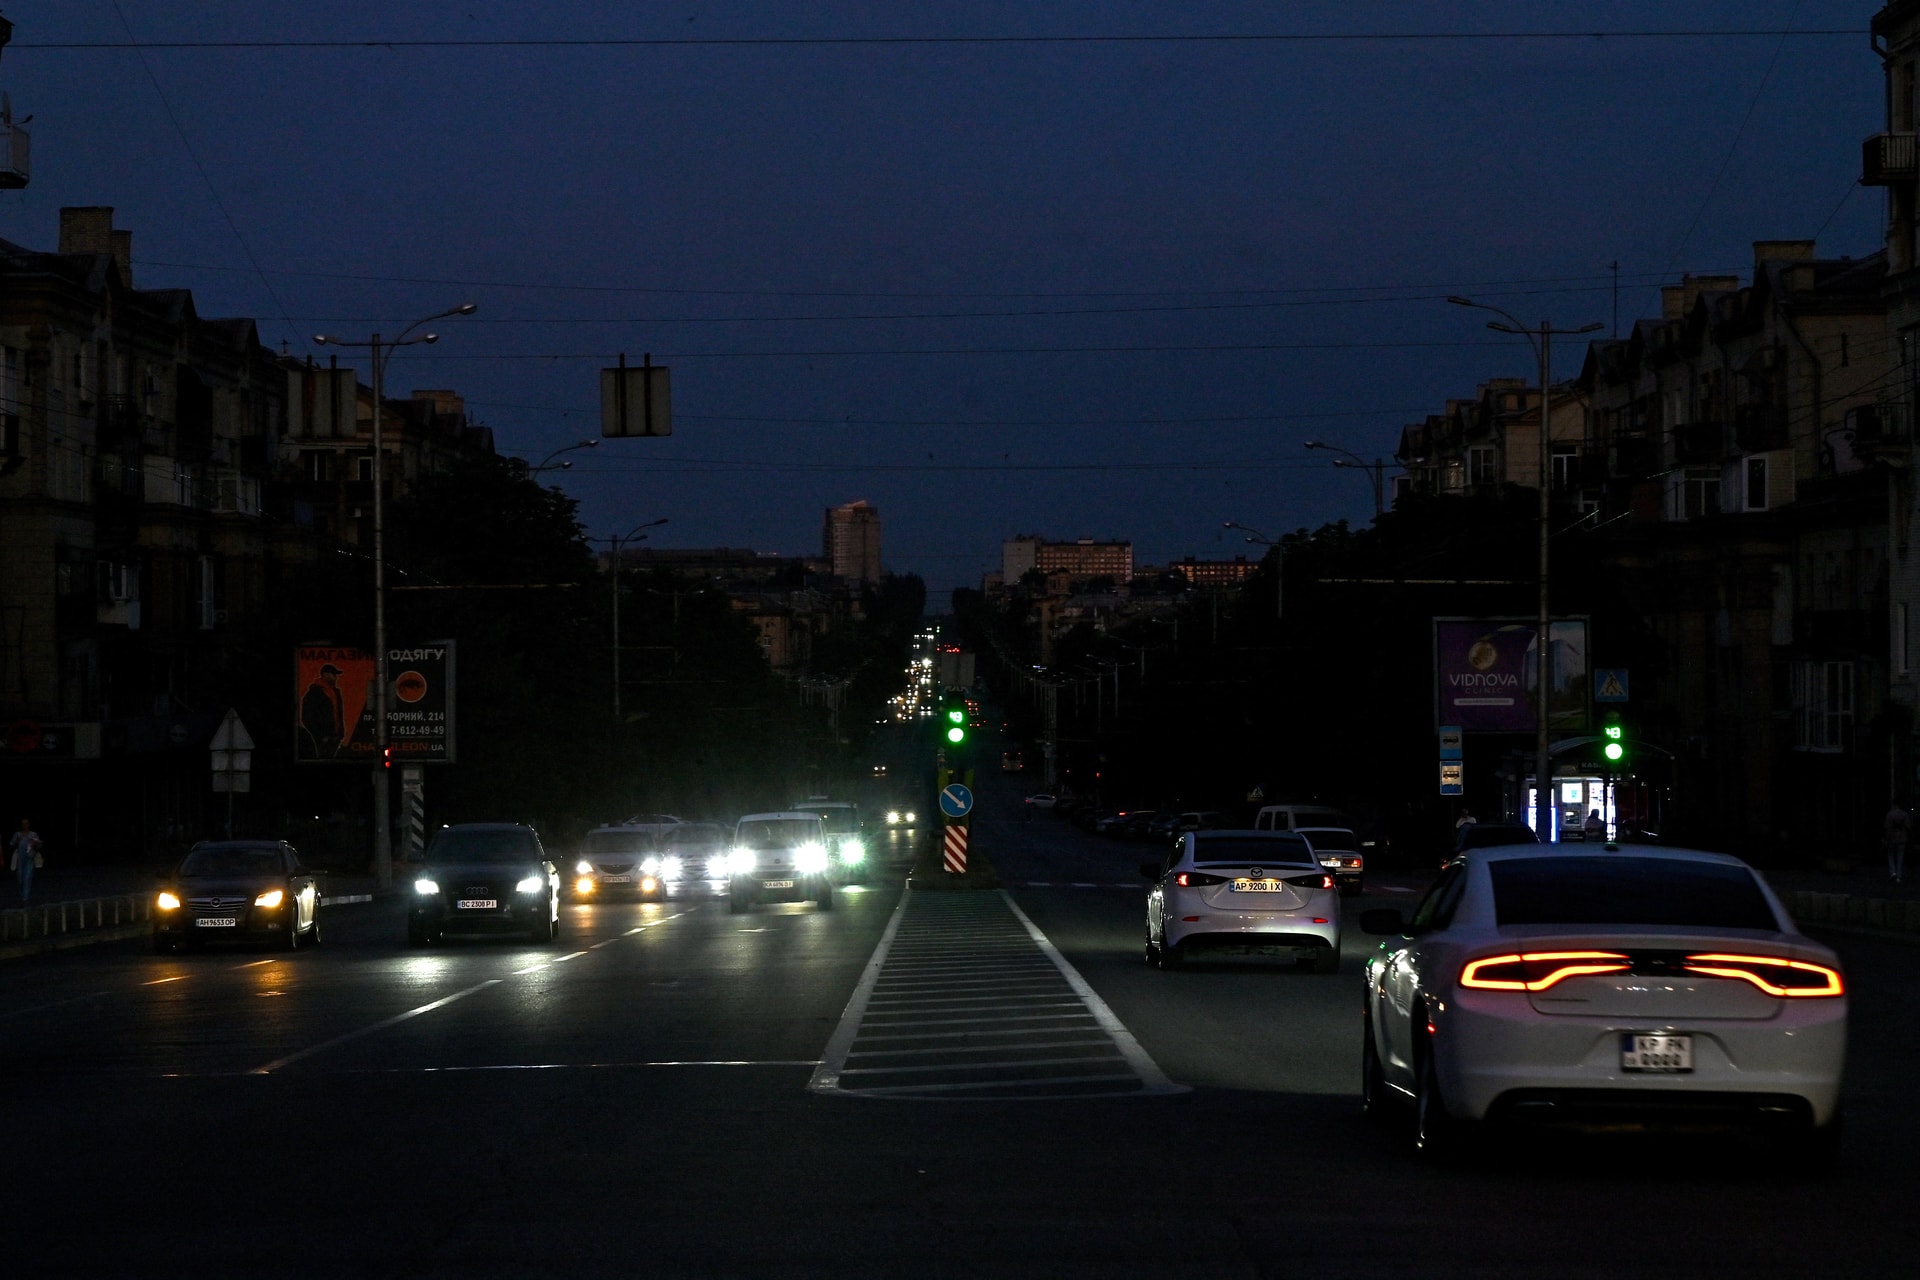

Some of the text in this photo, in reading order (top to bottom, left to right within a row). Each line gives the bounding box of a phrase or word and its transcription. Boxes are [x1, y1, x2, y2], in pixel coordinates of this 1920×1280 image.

[389, 648, 444, 662] ОДЯГУ
[1449, 673, 1518, 686] VIDNOVA
[428, 712, 444, 721] 214
[1235, 882, 1281, 891] AP 9200 IX
